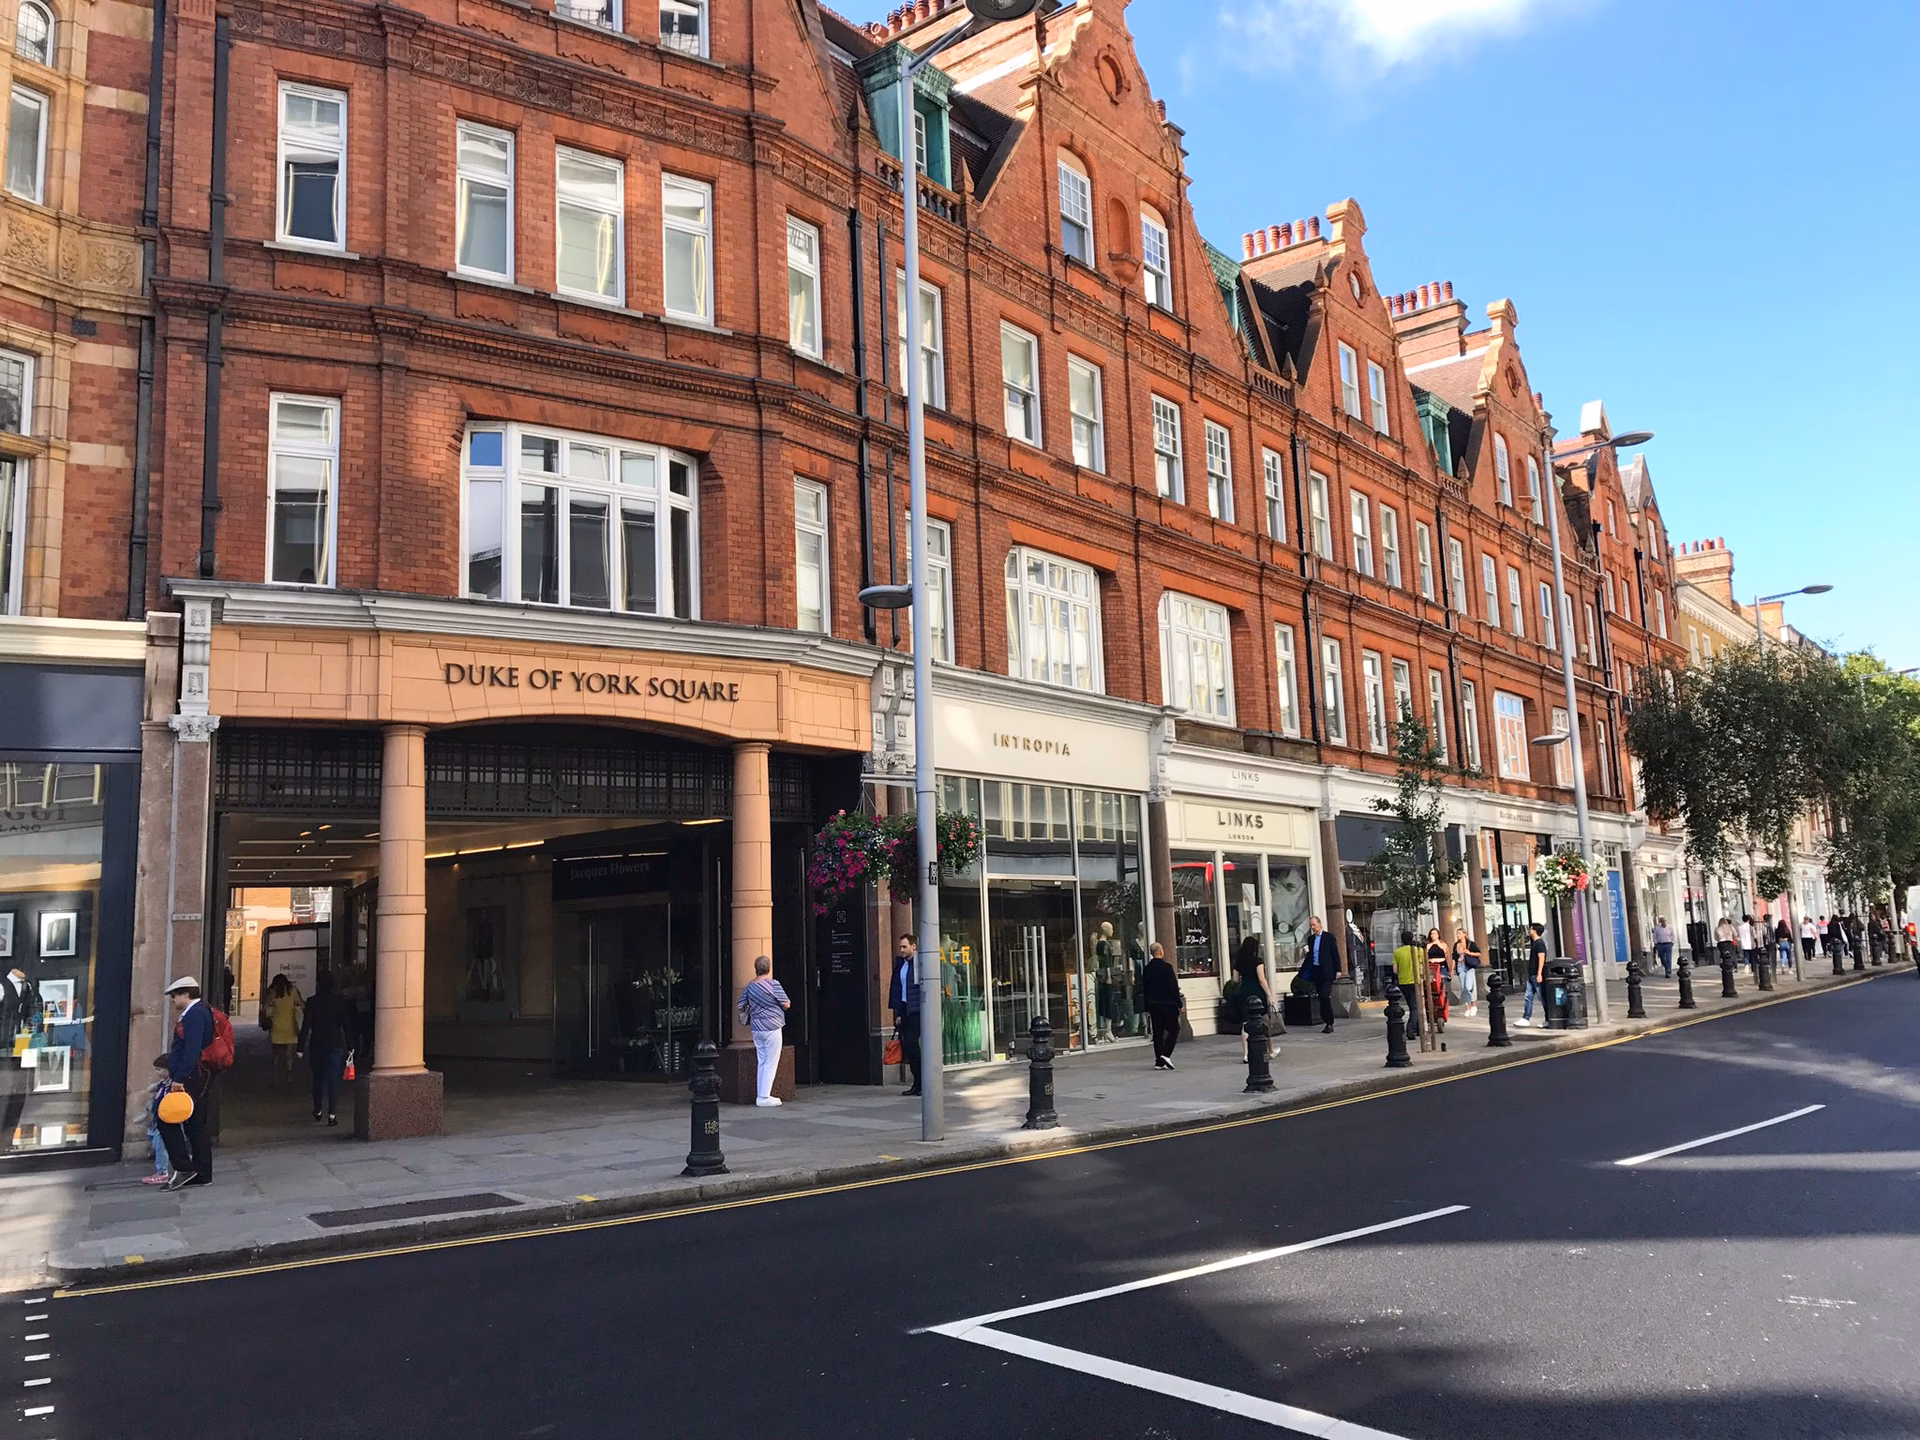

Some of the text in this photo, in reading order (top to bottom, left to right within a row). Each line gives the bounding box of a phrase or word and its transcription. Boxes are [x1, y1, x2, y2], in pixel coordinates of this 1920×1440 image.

[445, 662, 740, 703] DUKE OF YORK SQUARE
[993, 732, 1071, 757] INTROPIA
[1231, 770, 1260, 782] LINKS
[1217, 810, 1264, 829] LINKS
[569, 861, 650, 882] Jacques Flowers
[940, 945, 971, 964] ALE
